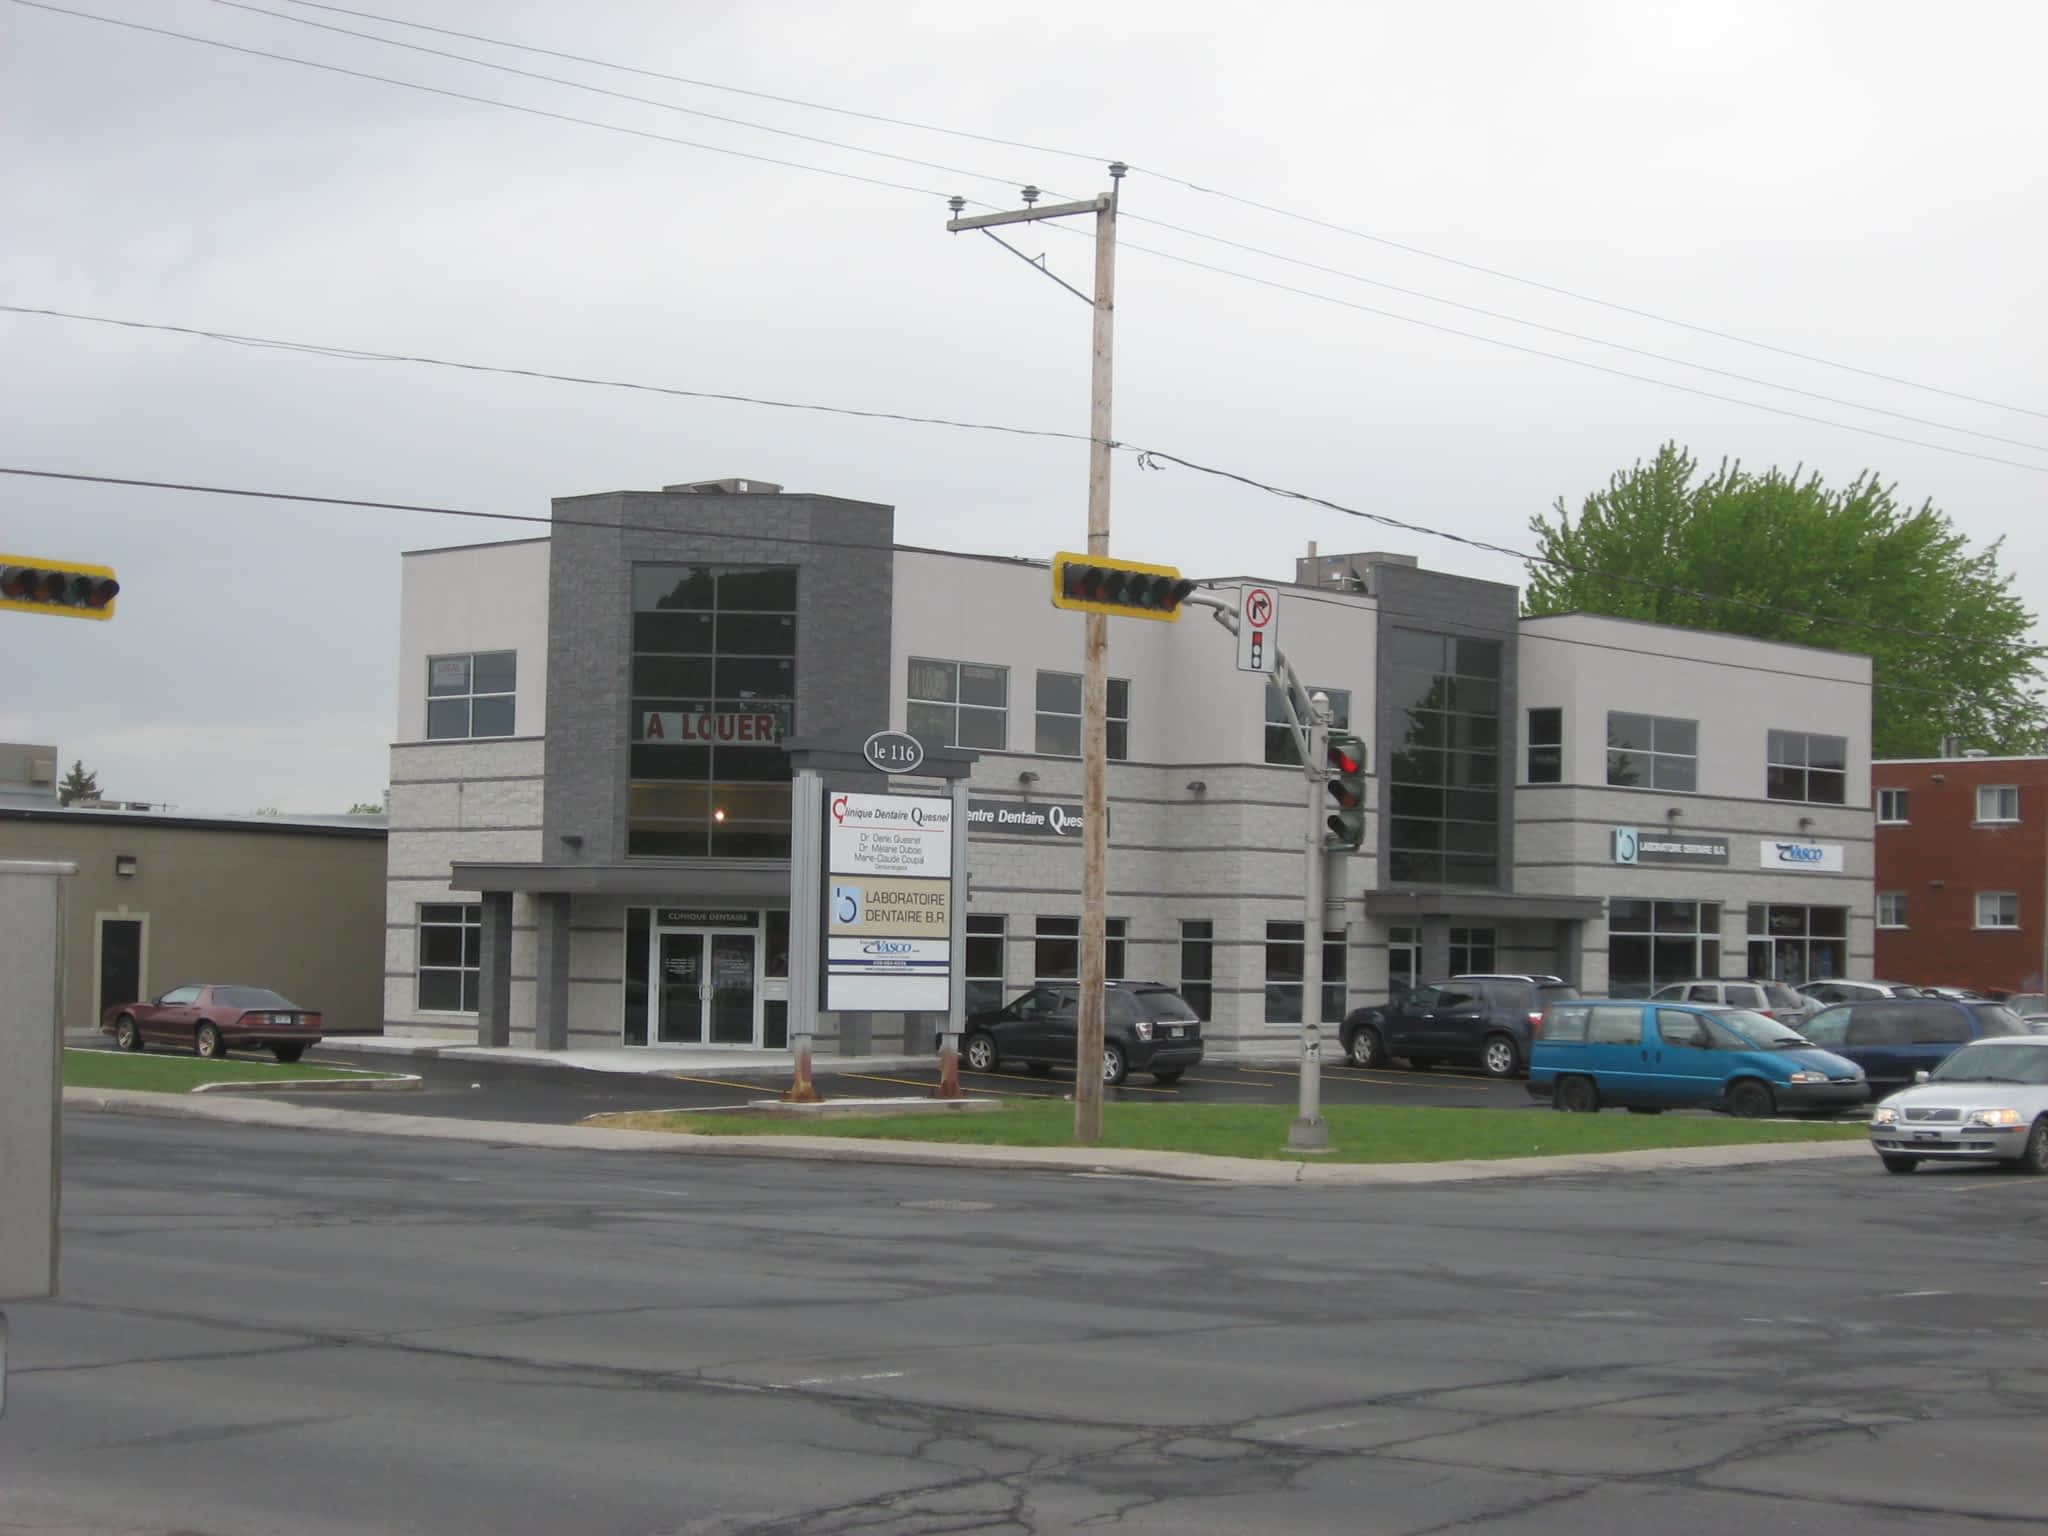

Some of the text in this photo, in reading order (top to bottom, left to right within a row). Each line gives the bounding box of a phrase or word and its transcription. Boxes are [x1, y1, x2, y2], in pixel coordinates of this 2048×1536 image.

[647, 712, 774, 741] A LOUER
[873, 741, 915, 762] le 116
[832, 795, 950, 828] Clinique Dentaire Quesnel
[967, 805, 1084, 836] entre Dentaire Ques
[865, 891, 945, 907] LABORATOIRE
[865, 909, 923, 924] DENTAIRE
[876, 943, 912, 953] VASCO
